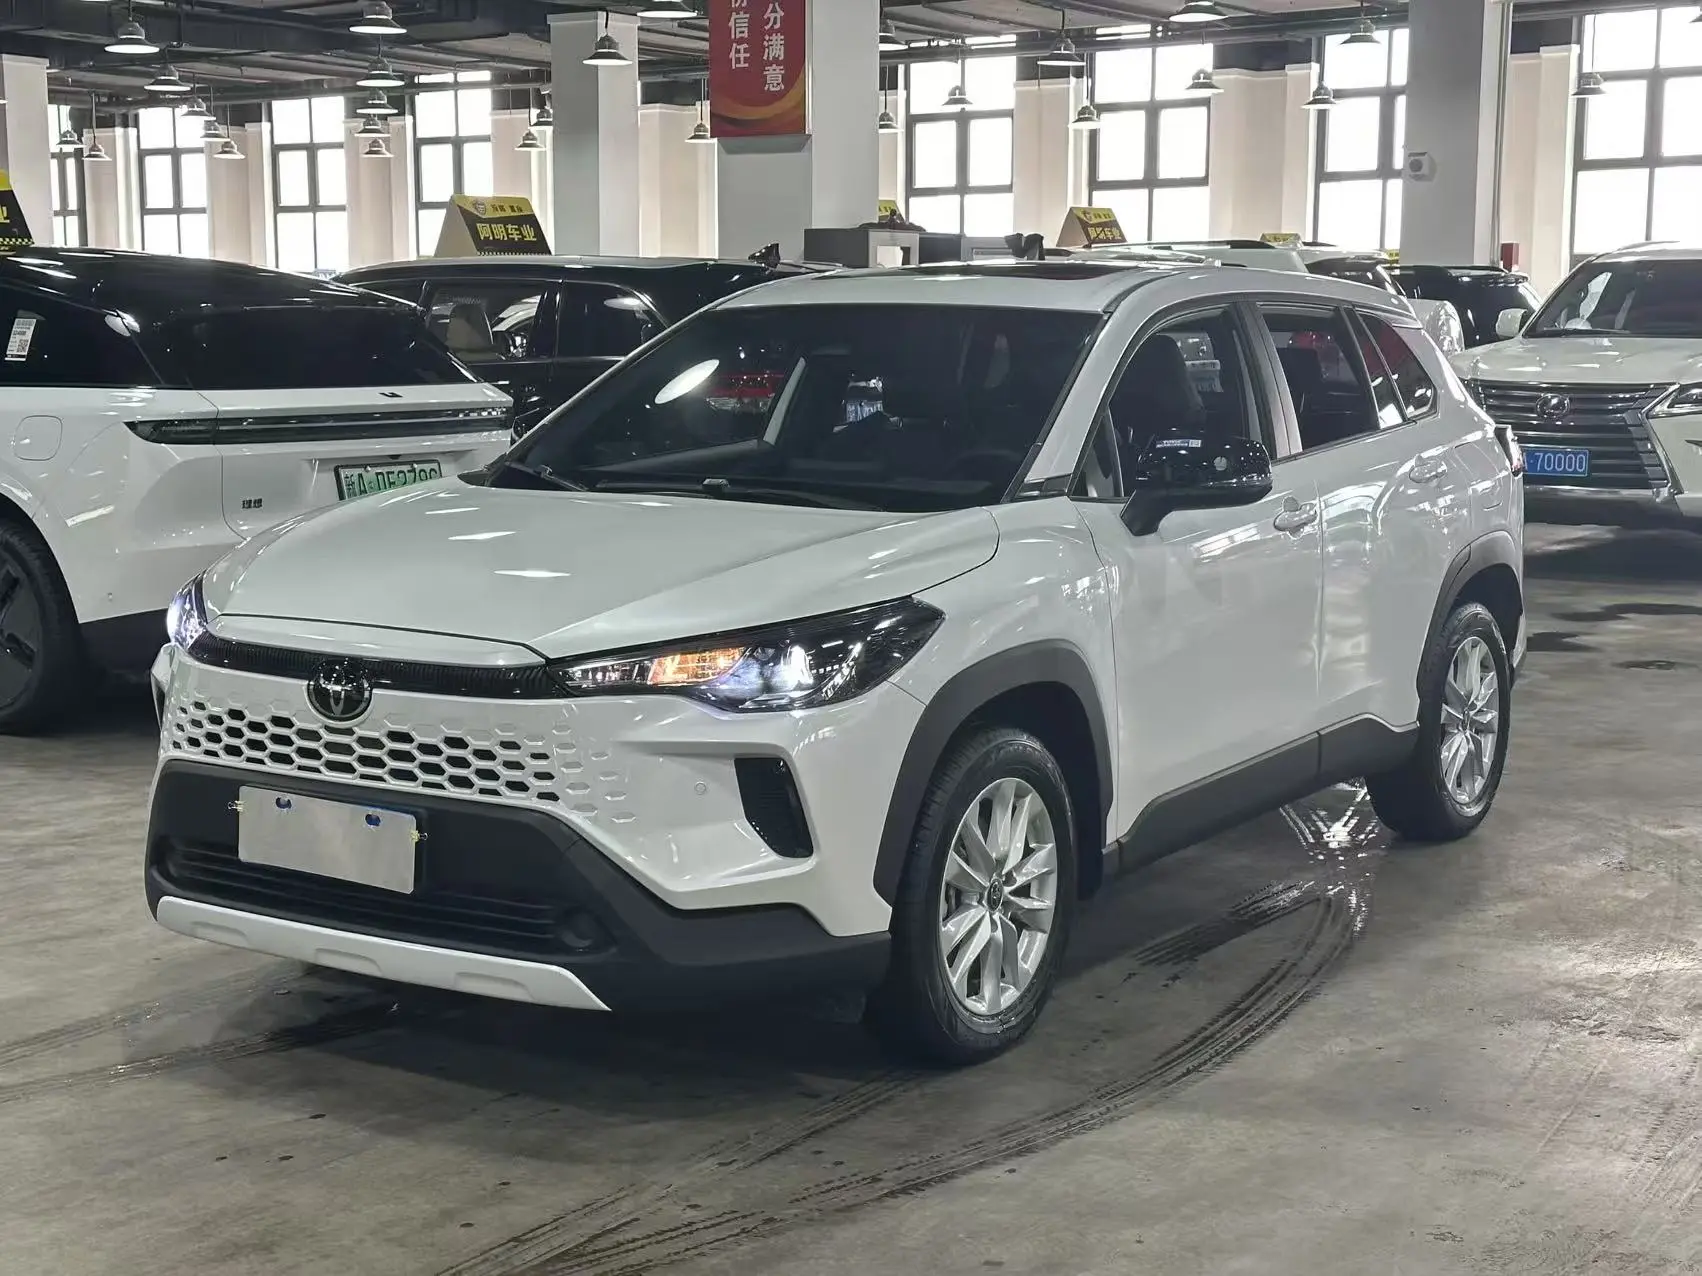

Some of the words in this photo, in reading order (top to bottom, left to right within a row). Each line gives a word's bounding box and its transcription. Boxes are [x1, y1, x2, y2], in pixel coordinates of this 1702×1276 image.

[763, 2, 785, 91] 分满意
[476, 223, 537, 241] 阿明车业
